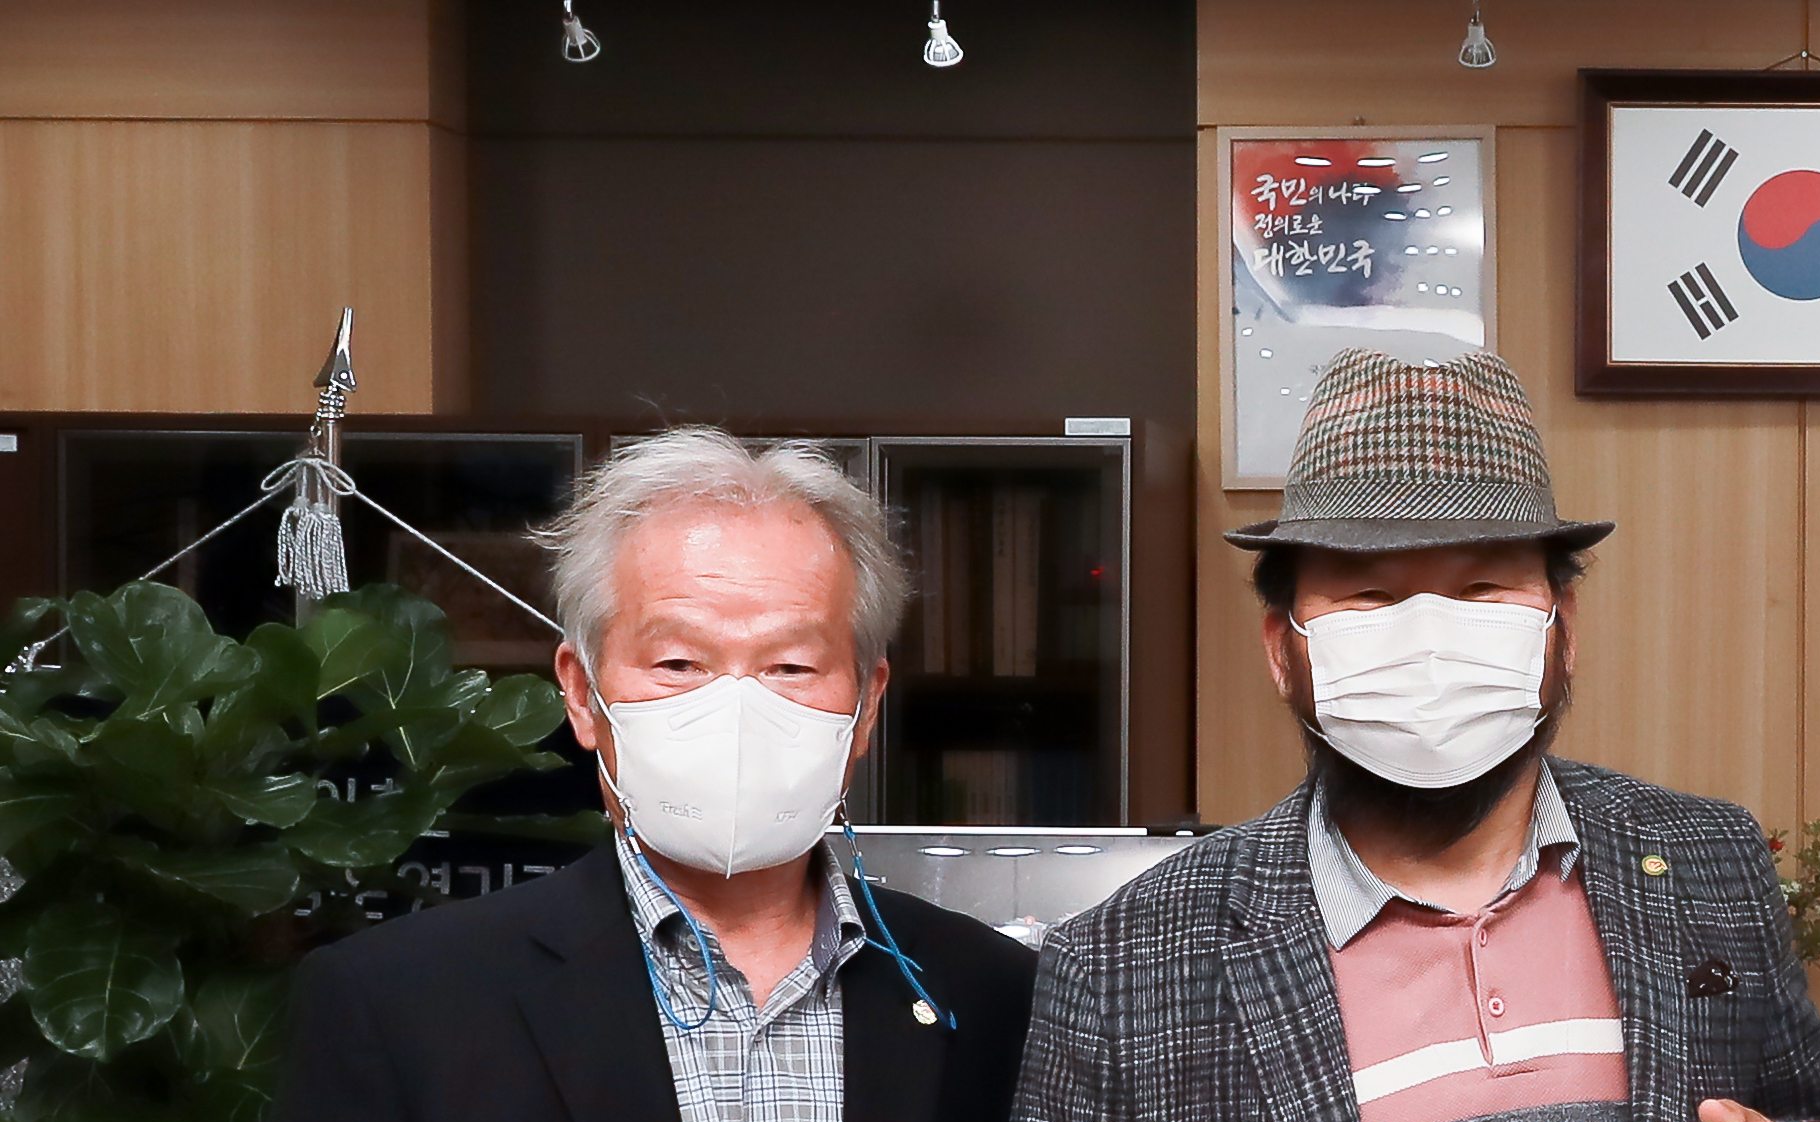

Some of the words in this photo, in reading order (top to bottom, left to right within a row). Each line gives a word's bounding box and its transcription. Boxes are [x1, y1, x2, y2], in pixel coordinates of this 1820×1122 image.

[1250, 174, 1323, 211] 국민의
[1254, 213, 1323, 238] 정의로운
[1253, 240, 1376, 279] 대한민국
